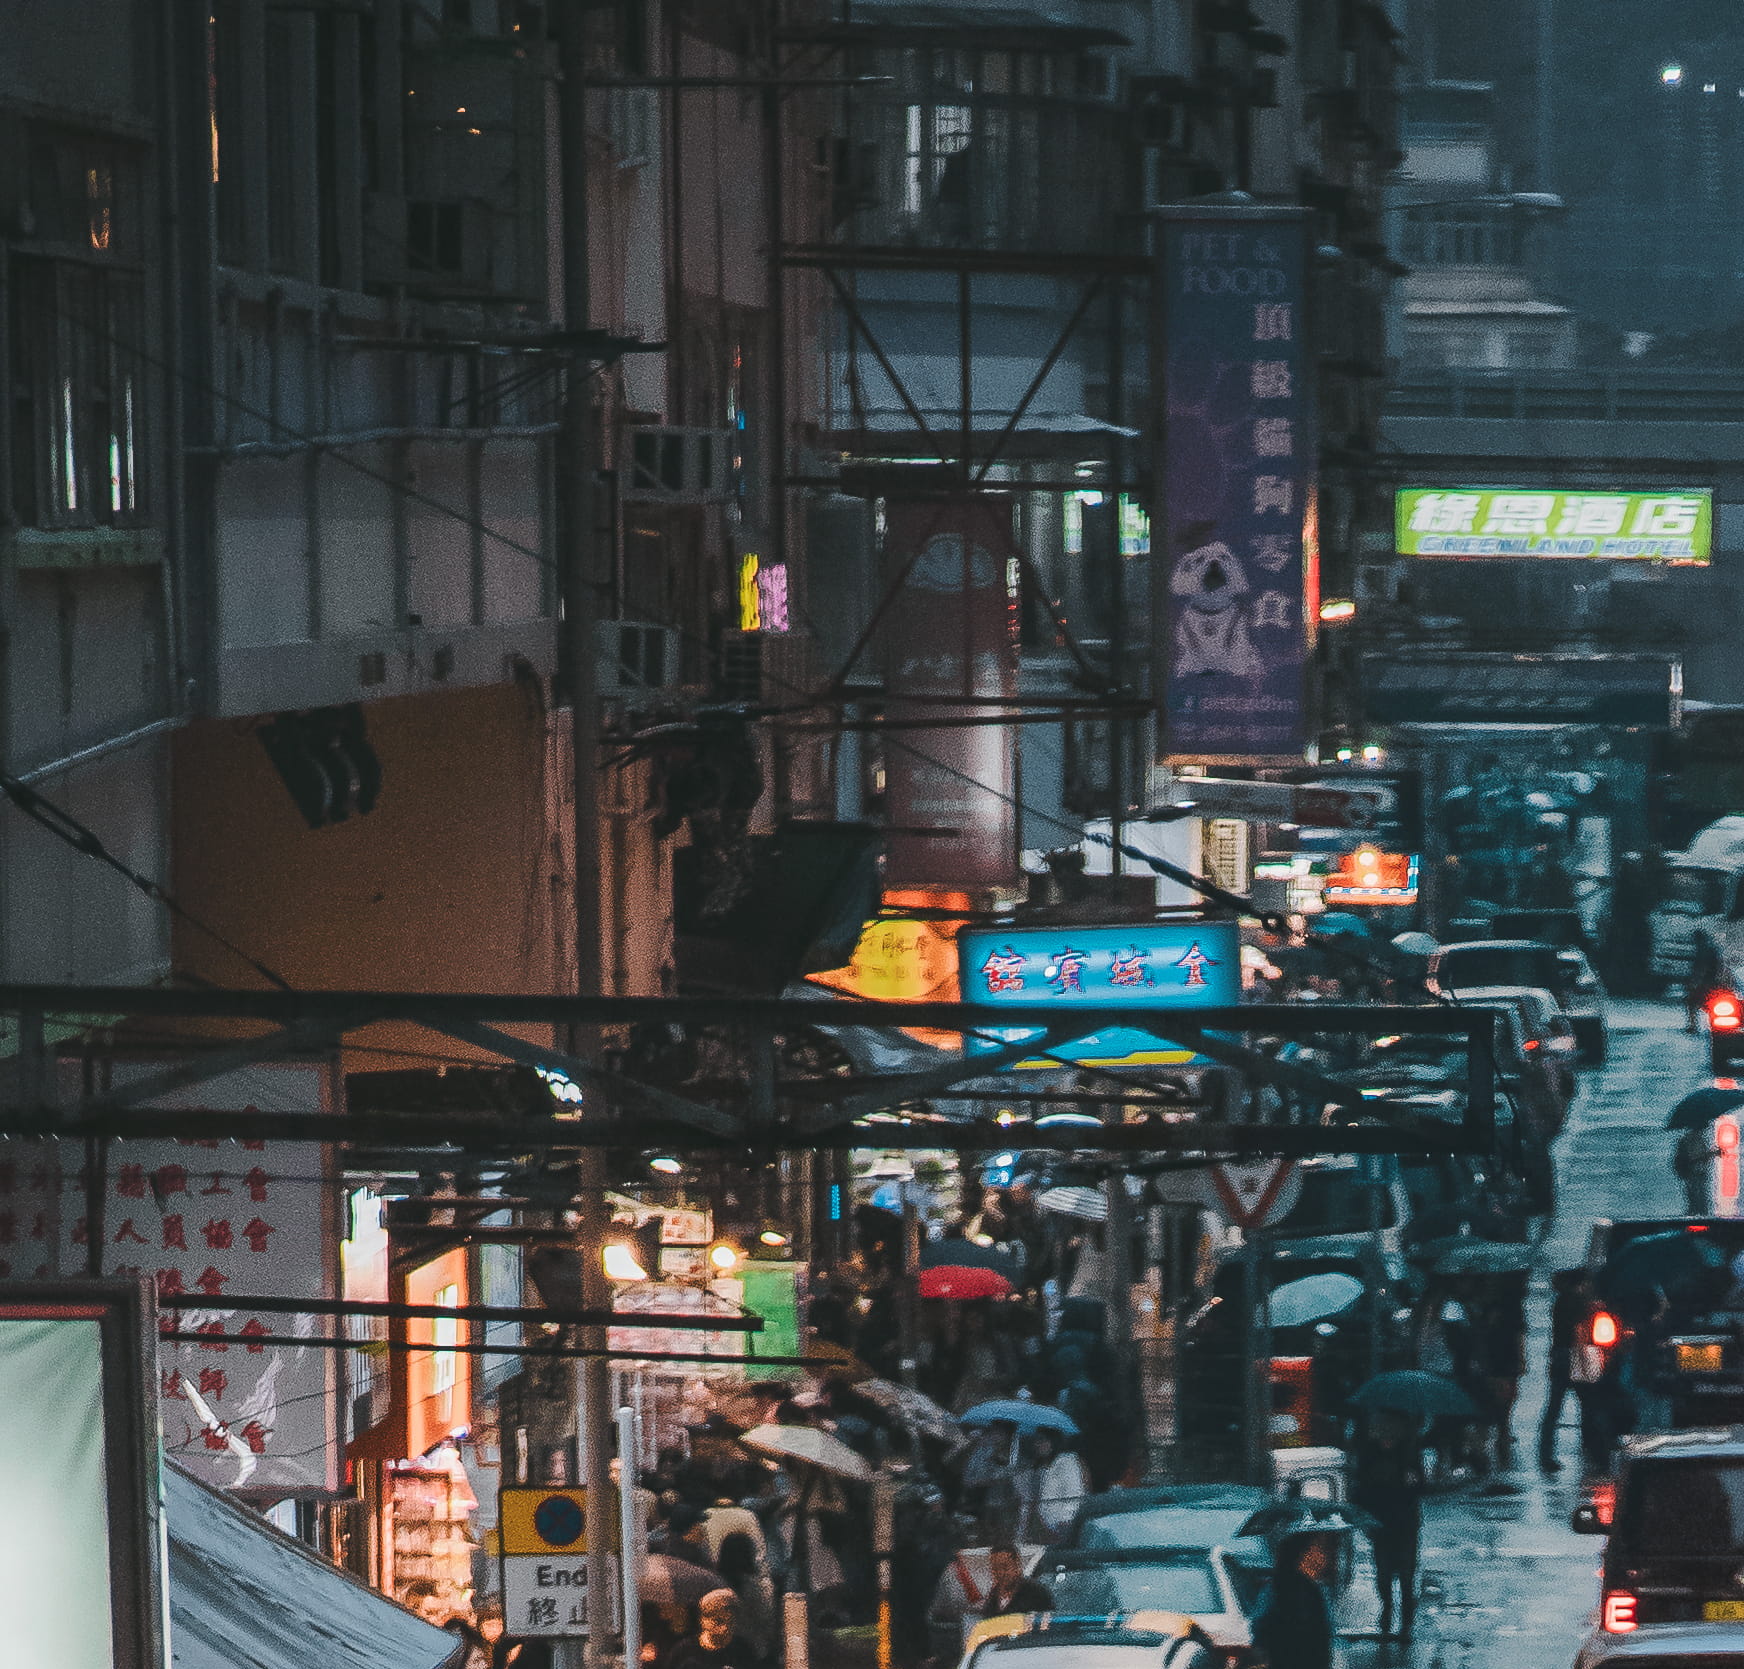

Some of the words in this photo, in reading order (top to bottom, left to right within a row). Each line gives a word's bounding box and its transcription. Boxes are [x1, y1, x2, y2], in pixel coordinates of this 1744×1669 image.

[1182, 233, 1241, 261] PET
[1182, 266, 1288, 295] FOOD
[1416, 535, 1595, 556] GREENLAND
[1602, 538, 1697, 558] HOTEL
[537, 1564, 589, 1588] End
